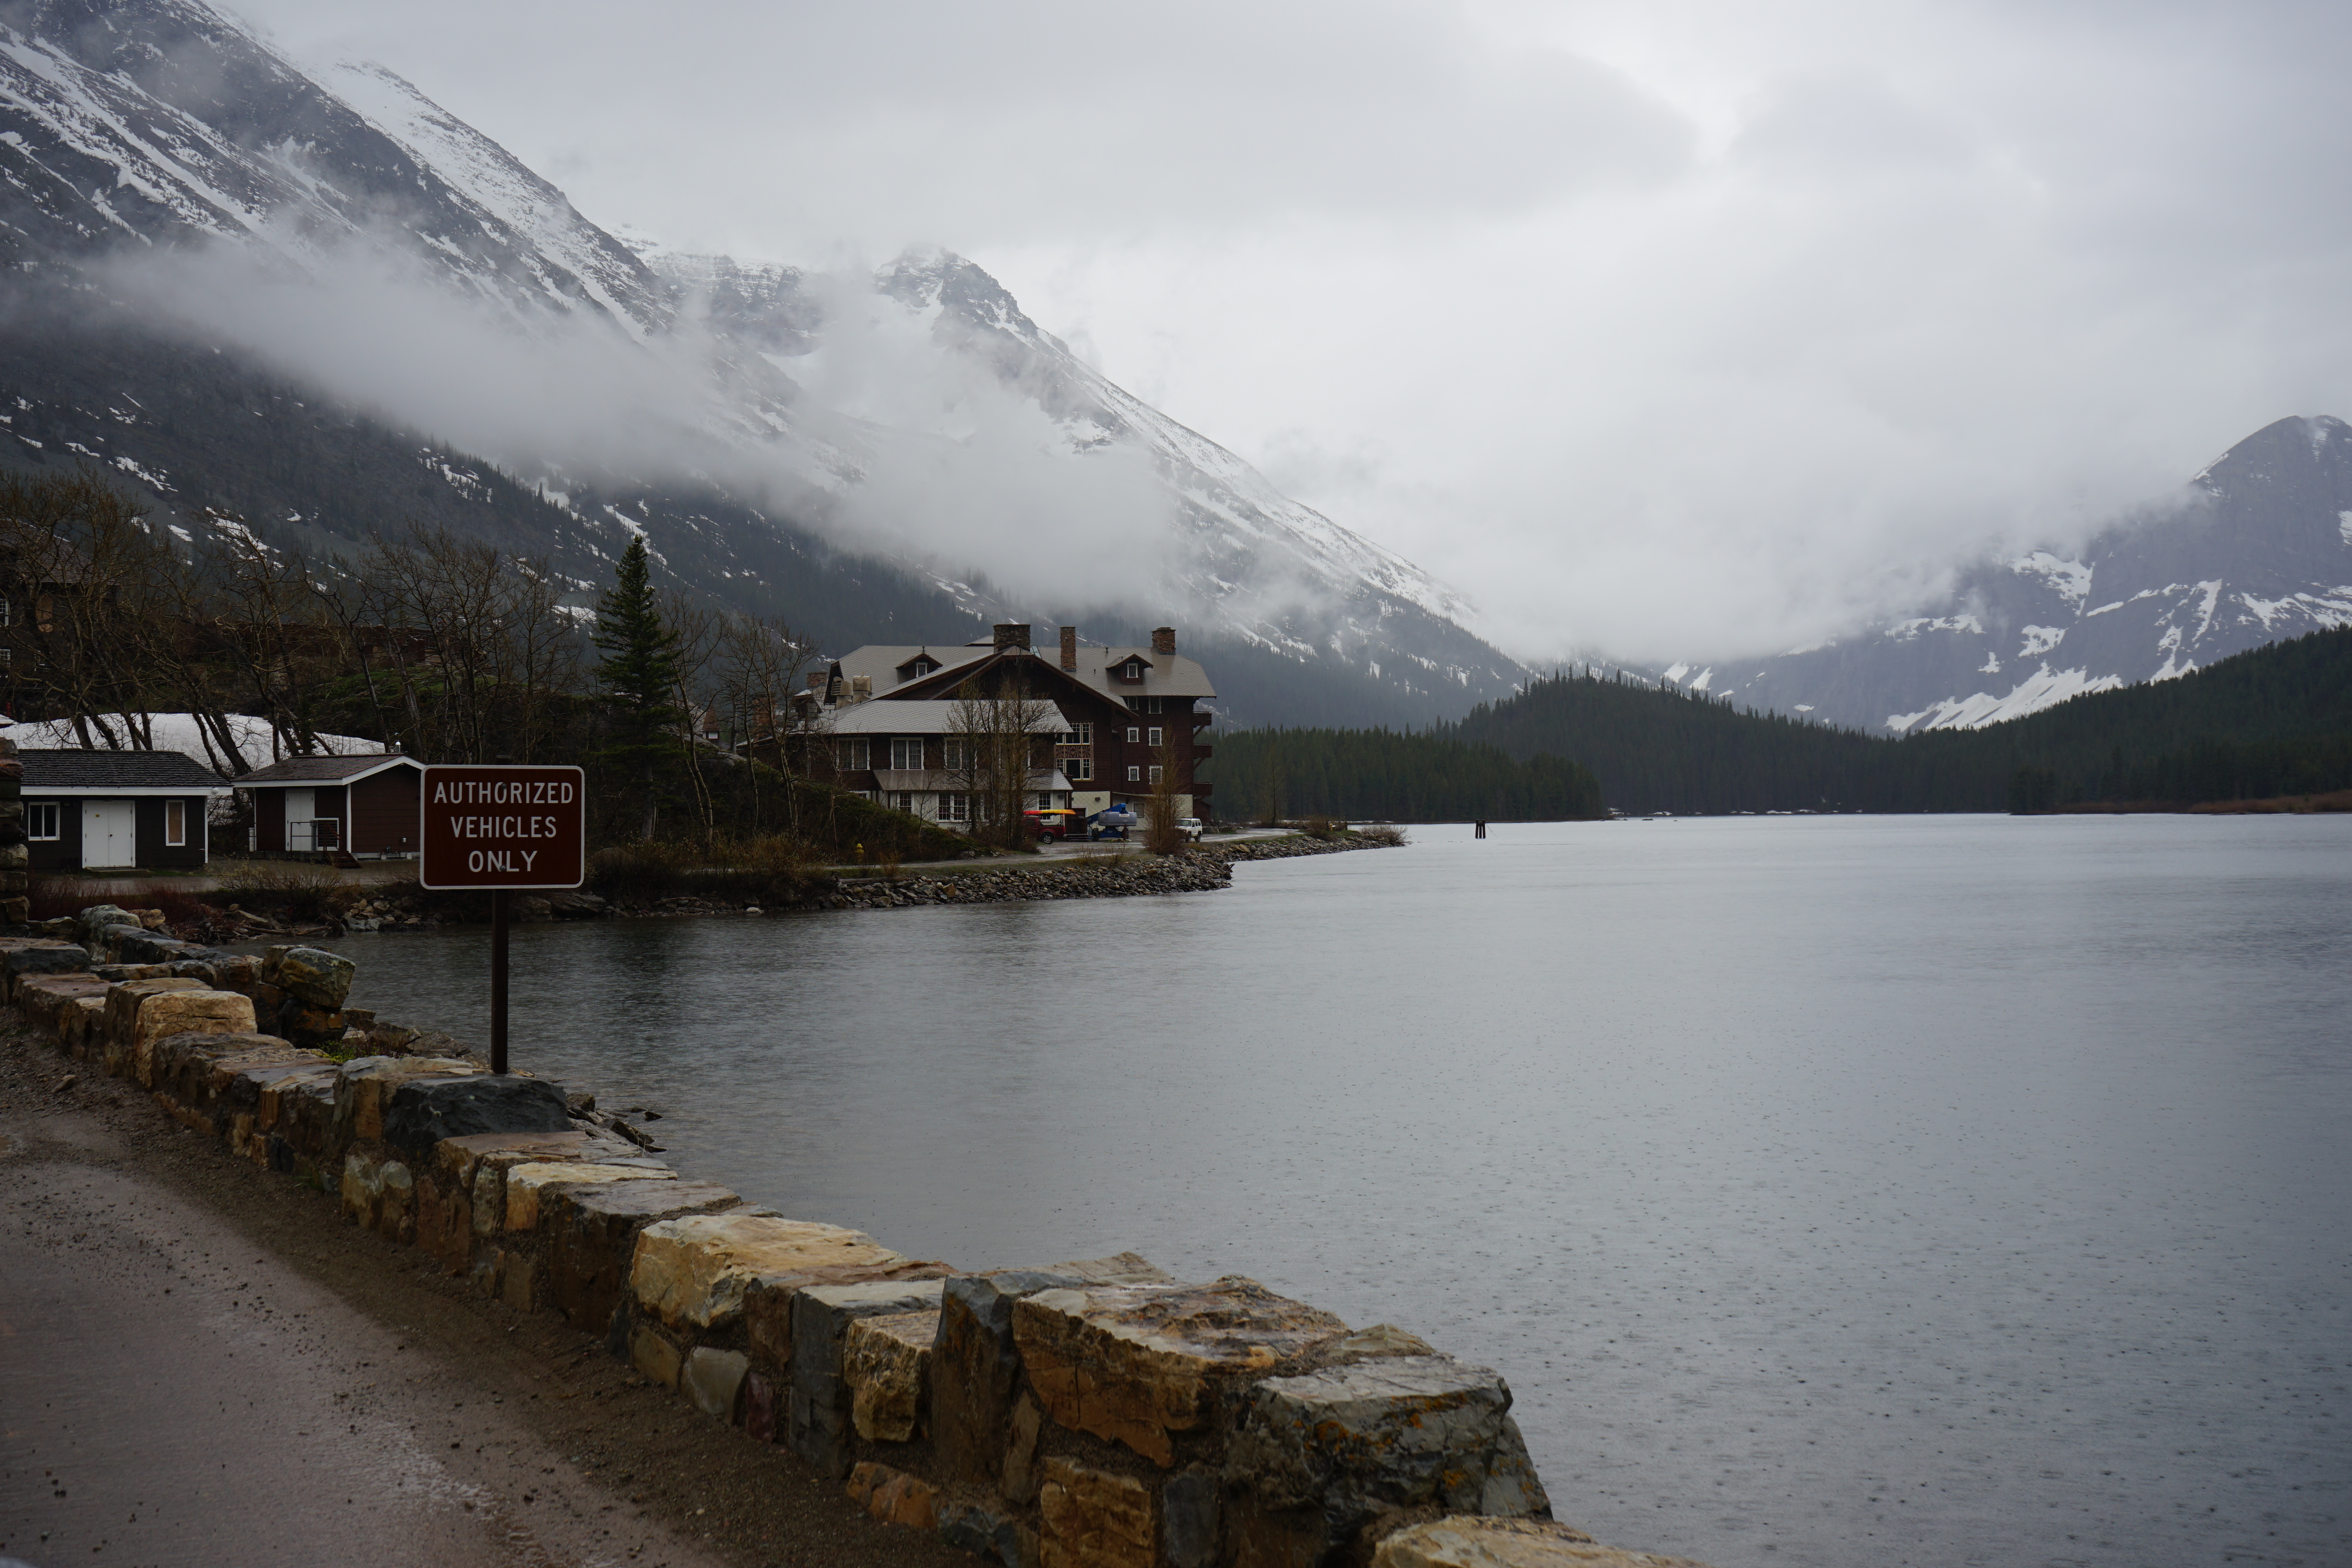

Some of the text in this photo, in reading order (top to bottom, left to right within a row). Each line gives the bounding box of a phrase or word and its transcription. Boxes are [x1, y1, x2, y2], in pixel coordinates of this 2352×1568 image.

[434, 782, 573, 804] AUTHORIZED
[450, 816, 556, 838] VEHICLES
[469, 851, 537, 872] ONLY
